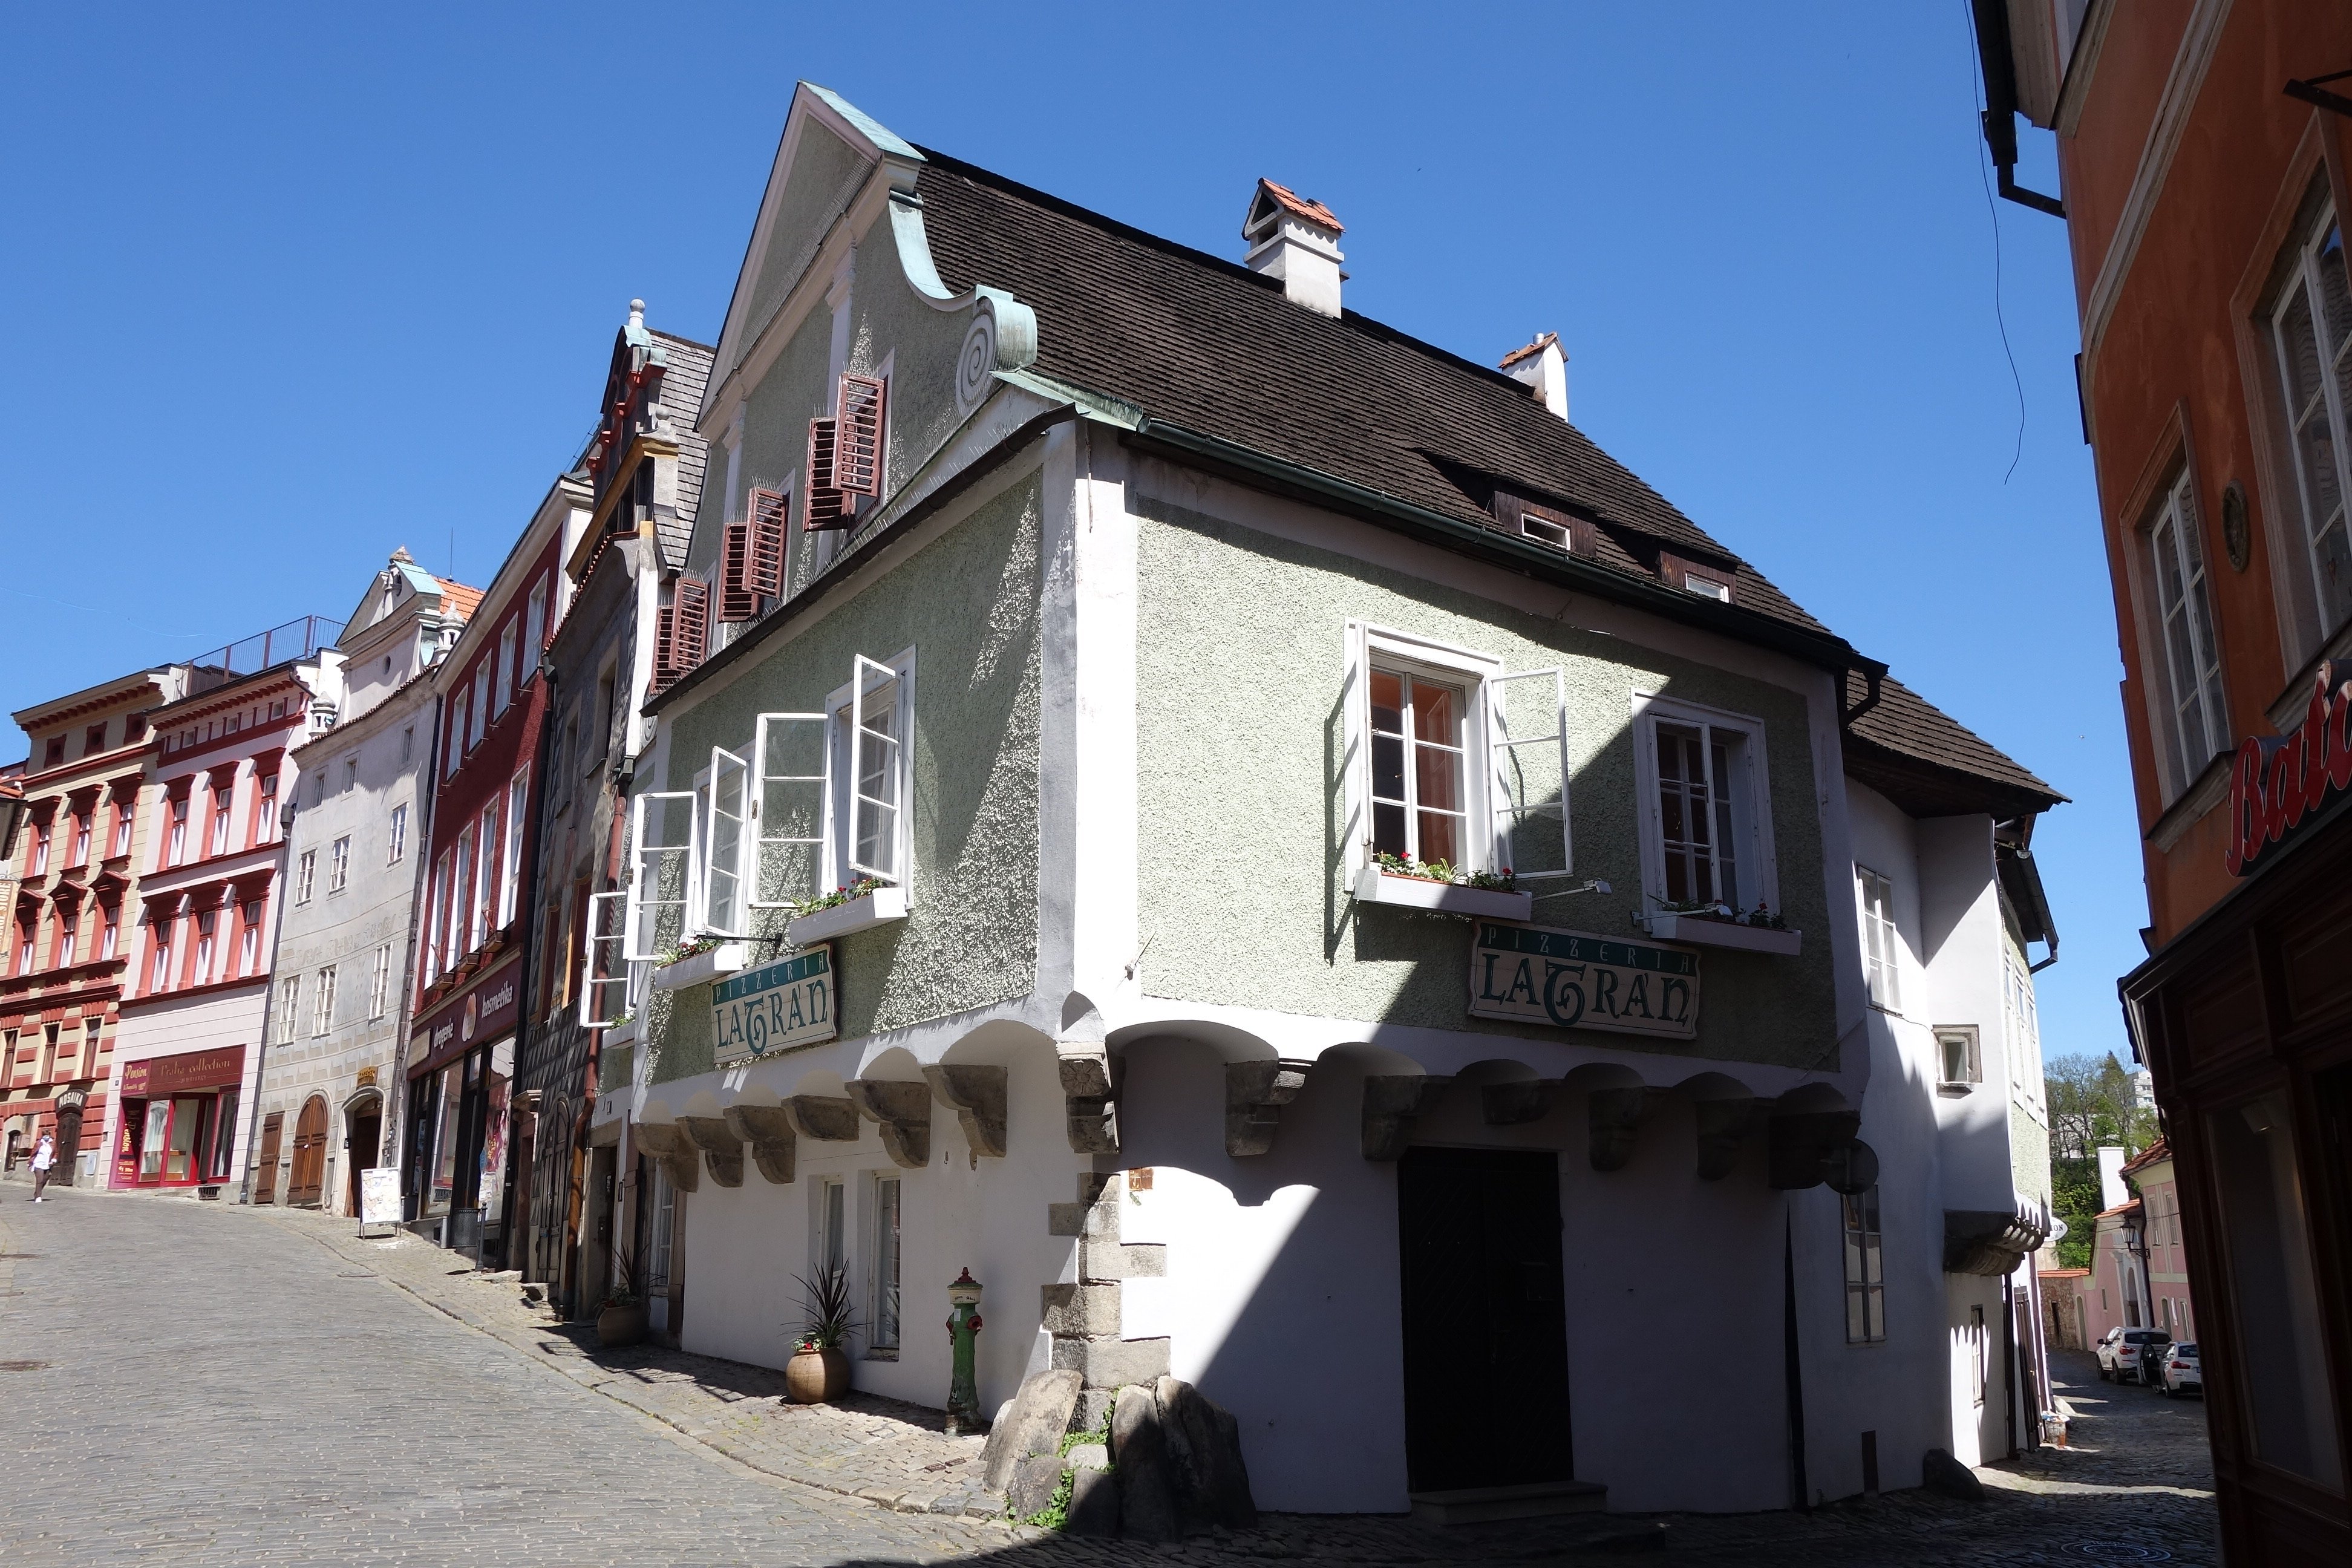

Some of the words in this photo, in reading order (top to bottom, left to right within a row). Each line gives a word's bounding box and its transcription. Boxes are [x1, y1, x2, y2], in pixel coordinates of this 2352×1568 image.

[1488, 927, 1689, 973] PIZZERIA
[716, 953, 824, 1002] PIZZERIA
[434, 1018, 454, 1050] drogerie
[482, 981, 513, 1018] kosmetika
[125, 1065, 147, 1080] Pension
[189, 1057, 230, 1073] collection
[59, 1092, 83, 1108] MOSAIKA
